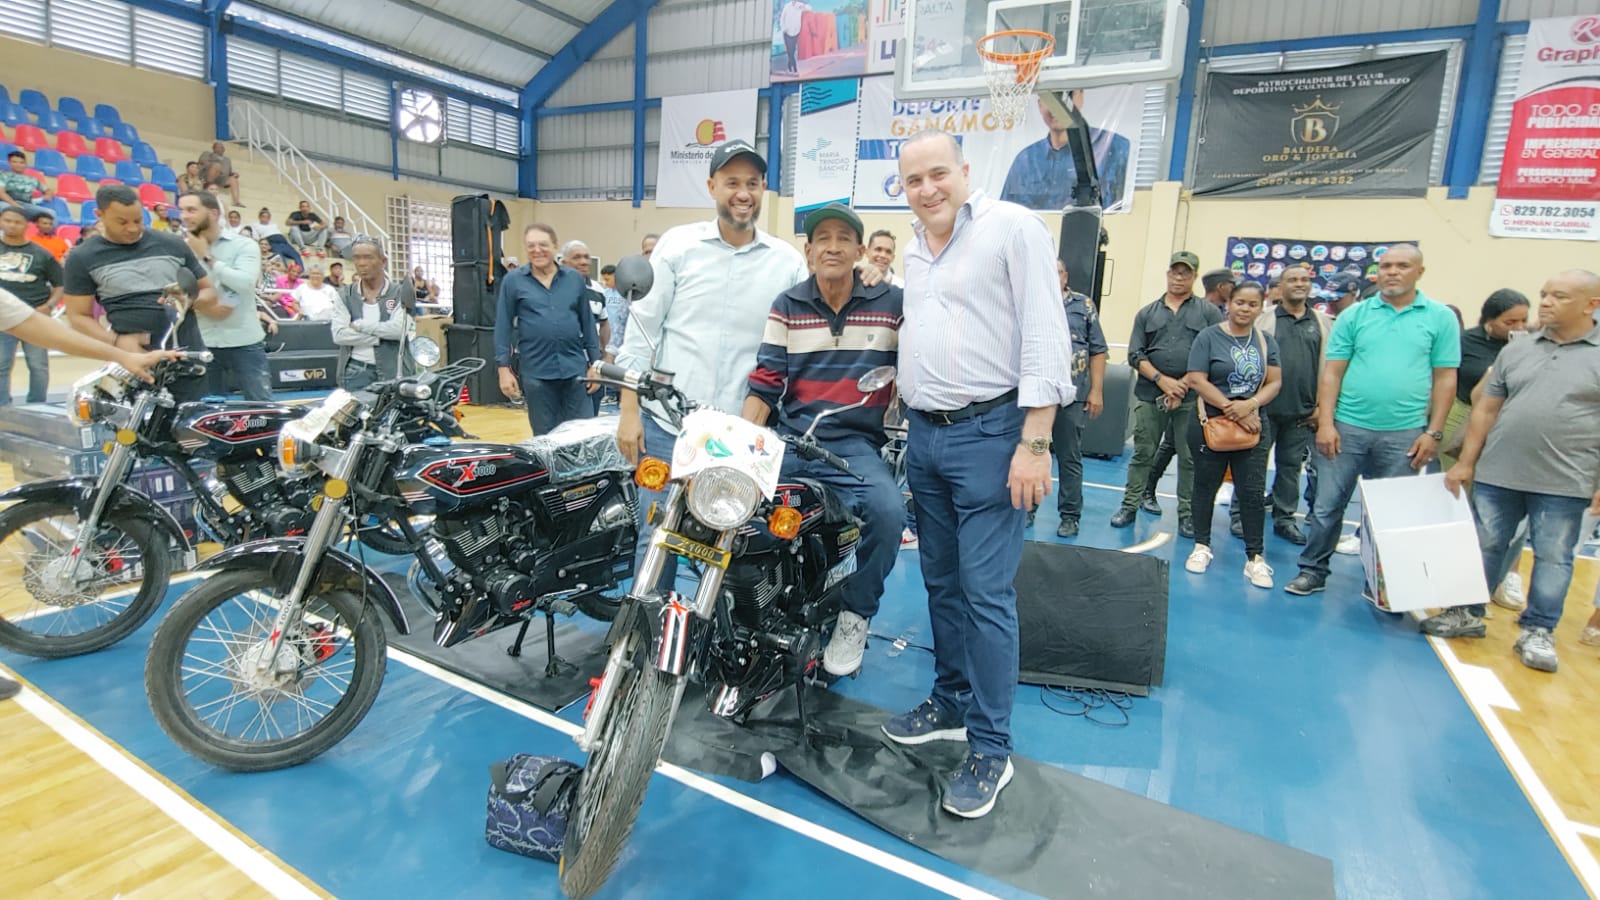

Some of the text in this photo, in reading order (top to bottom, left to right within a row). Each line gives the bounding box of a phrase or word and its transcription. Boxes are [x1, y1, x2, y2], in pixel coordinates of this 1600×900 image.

[1232, 85, 1287, 95] DEPORTIVO
[1297, 82, 1348, 91] CULTURAL
[1531, 104, 1582, 117] TODO
[1302, 118, 1327, 143] B
[1283, 146, 1338, 154] BALDERA
[1521, 149, 1599, 158] EN GENERAL
[671, 150, 704, 160] Ministerio
[1263, 154, 1289, 162] ORO
[305, 370, 324, 379] VIP
